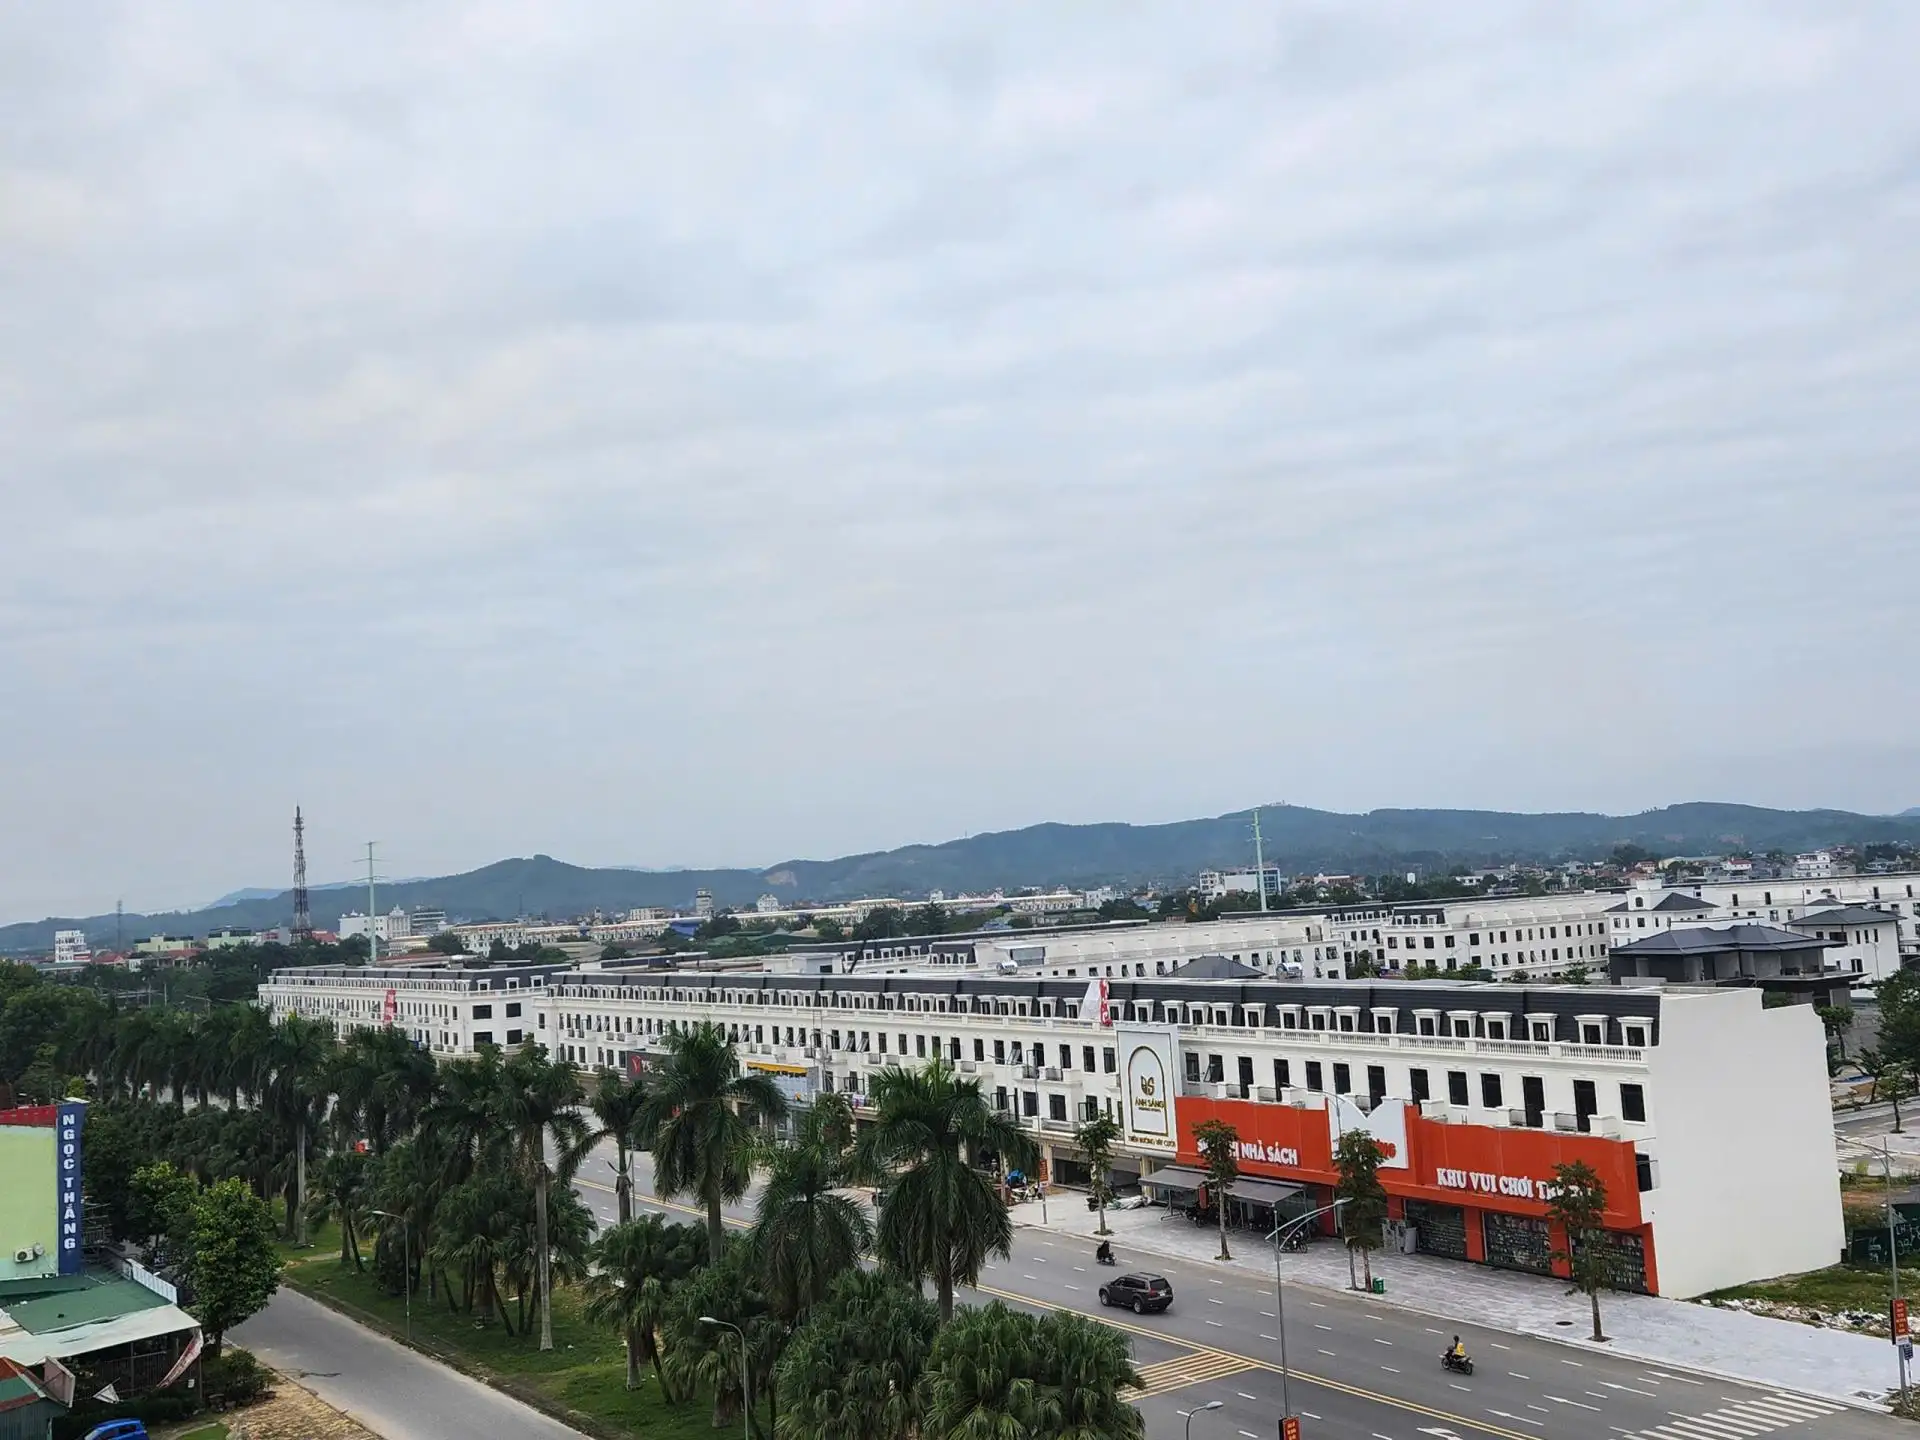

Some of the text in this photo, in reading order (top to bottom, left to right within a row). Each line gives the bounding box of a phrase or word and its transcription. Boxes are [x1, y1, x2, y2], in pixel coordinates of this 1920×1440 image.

[62, 1113, 76, 1170] NGỌC
[1241, 1138, 1266, 1161] NHÀ
[1266, 1141, 1298, 1165] SÁCH
[1436, 1167, 1467, 1189] KHU
[1469, 1171, 1498, 1193] VUI
